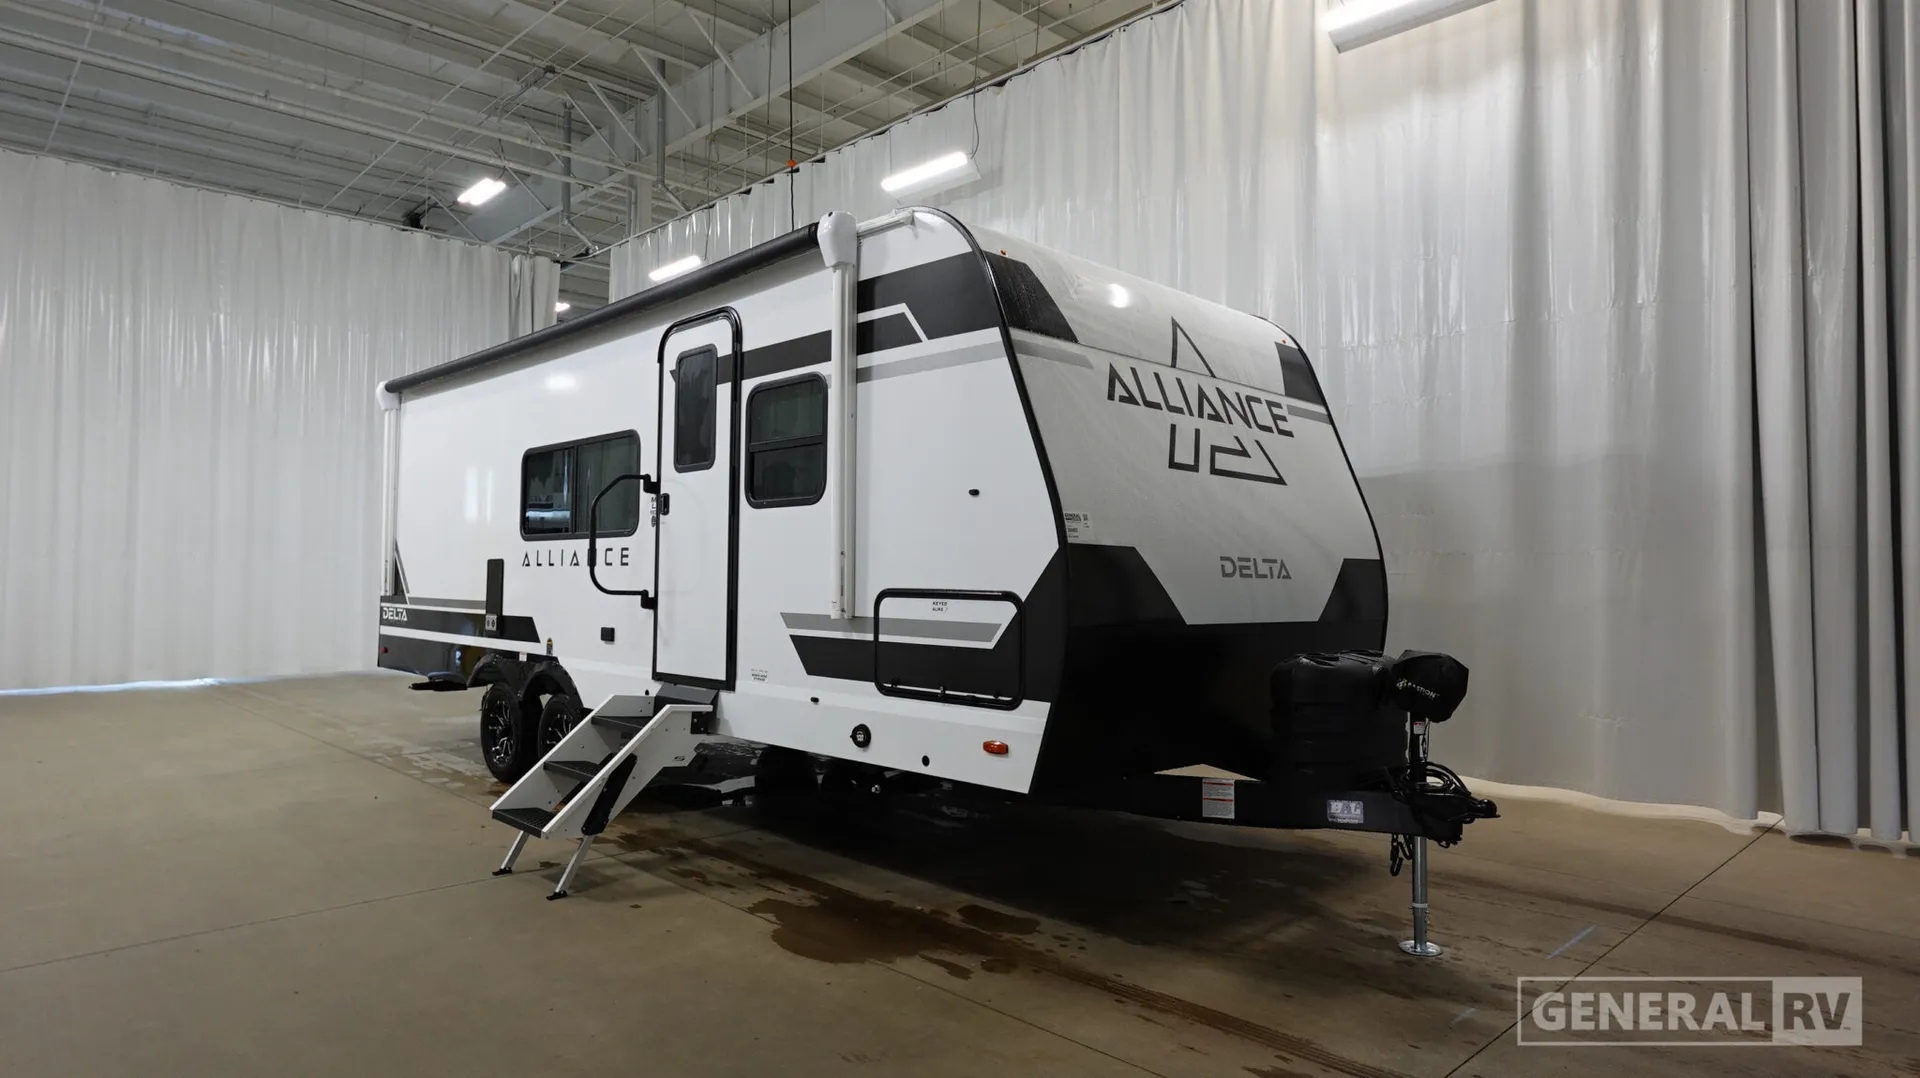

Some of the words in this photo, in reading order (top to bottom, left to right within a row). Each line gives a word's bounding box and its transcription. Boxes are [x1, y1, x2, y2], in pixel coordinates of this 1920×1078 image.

[1107, 362, 1294, 438] ALLIANCE
[522, 547, 630, 567] ALLIACE
[1220, 556, 1292, 579] DELTA
[382, 607, 408, 621] DELTA
